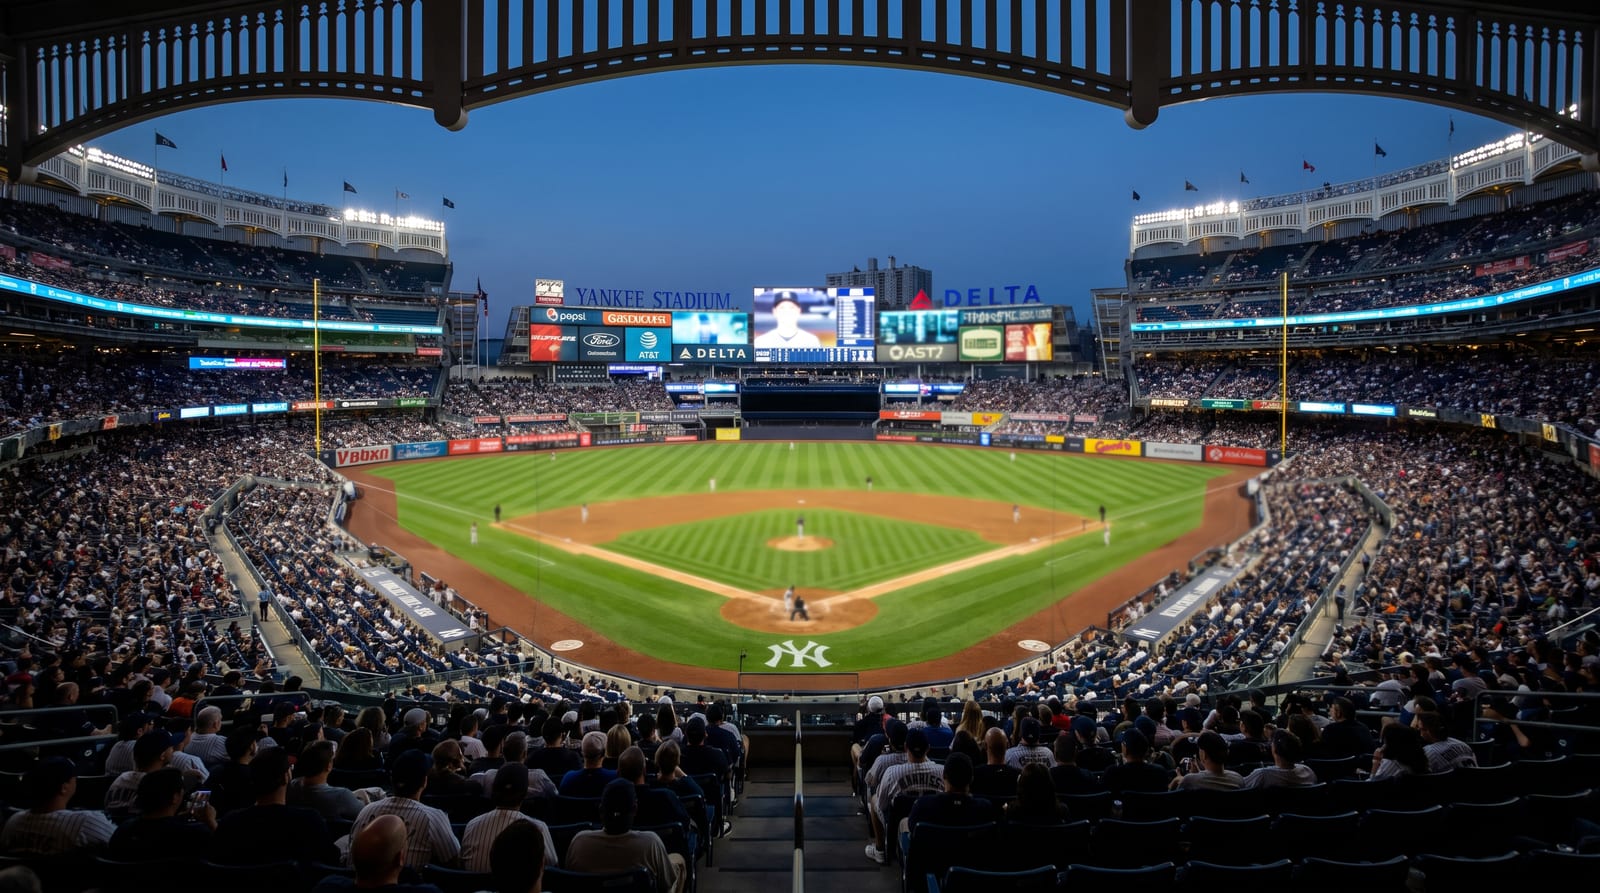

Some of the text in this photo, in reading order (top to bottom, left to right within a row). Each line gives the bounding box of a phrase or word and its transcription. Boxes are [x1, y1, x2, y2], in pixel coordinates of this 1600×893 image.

[576, 287, 731, 310] YANKEE STADIUM
[945, 284, 1041, 307] DELTA
[560, 312, 586, 322] pepsi
[639, 351, 660, 359] AT&T
[697, 348, 746, 359] DELTA
